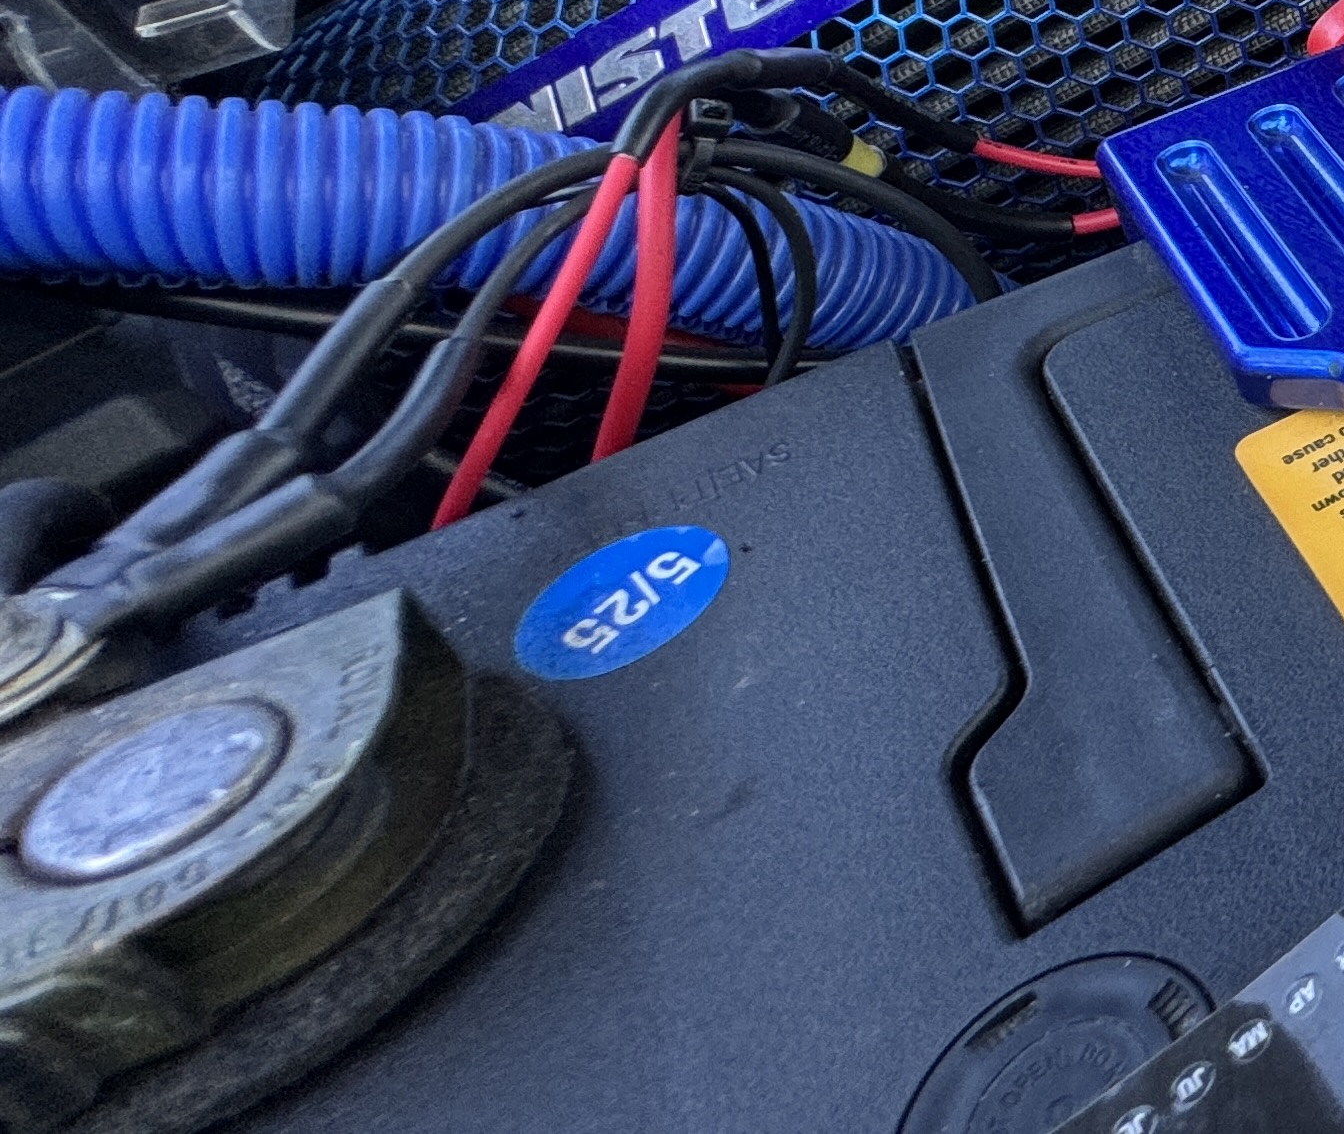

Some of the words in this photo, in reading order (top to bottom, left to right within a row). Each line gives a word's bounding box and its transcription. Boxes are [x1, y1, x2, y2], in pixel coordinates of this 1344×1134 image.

[1281, 433, 1336, 466] cause
[561, 551, 702, 654] 5/25
[1288, 977, 1317, 1015] AP
[1227, 1021, 1268, 1059] MA
[1175, 1066, 1205, 1101] JU
